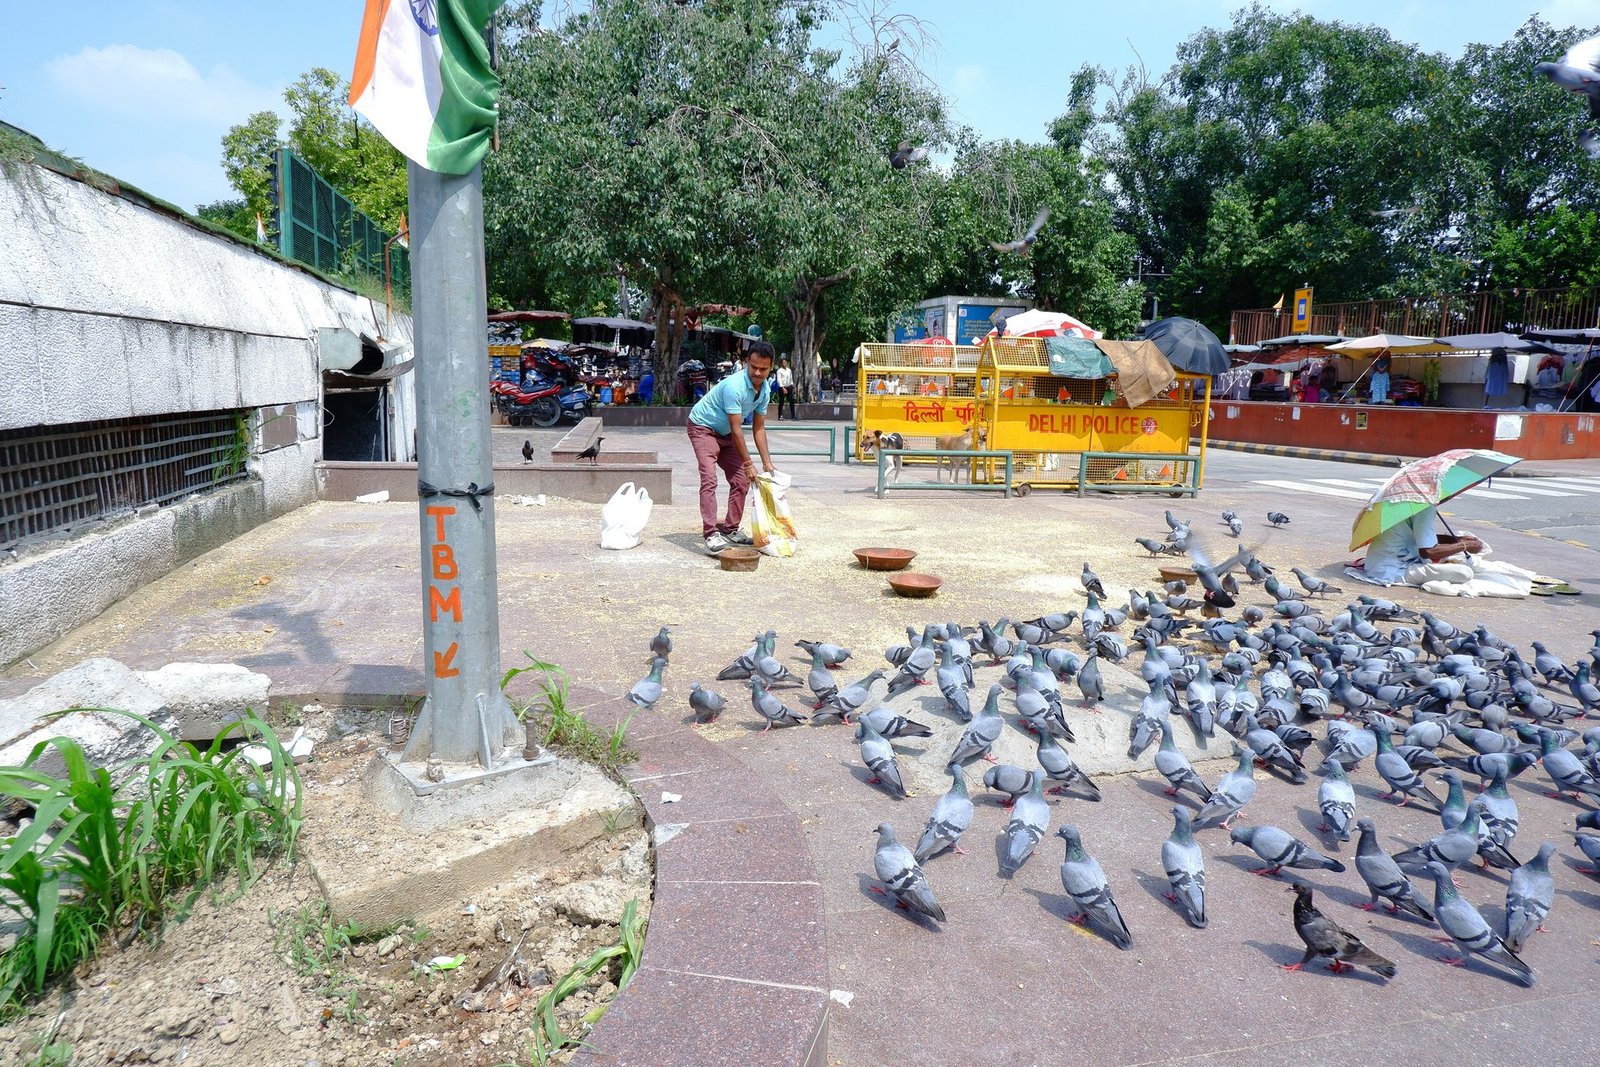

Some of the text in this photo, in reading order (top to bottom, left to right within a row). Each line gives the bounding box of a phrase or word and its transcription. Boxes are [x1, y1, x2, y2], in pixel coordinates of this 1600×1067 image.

[903, 401, 945, 422] दिल्ली
[1029, 414, 1077, 434] DELHI
[1082, 415, 1139, 435] POLICE
[426, 506, 463, 623] TBM
